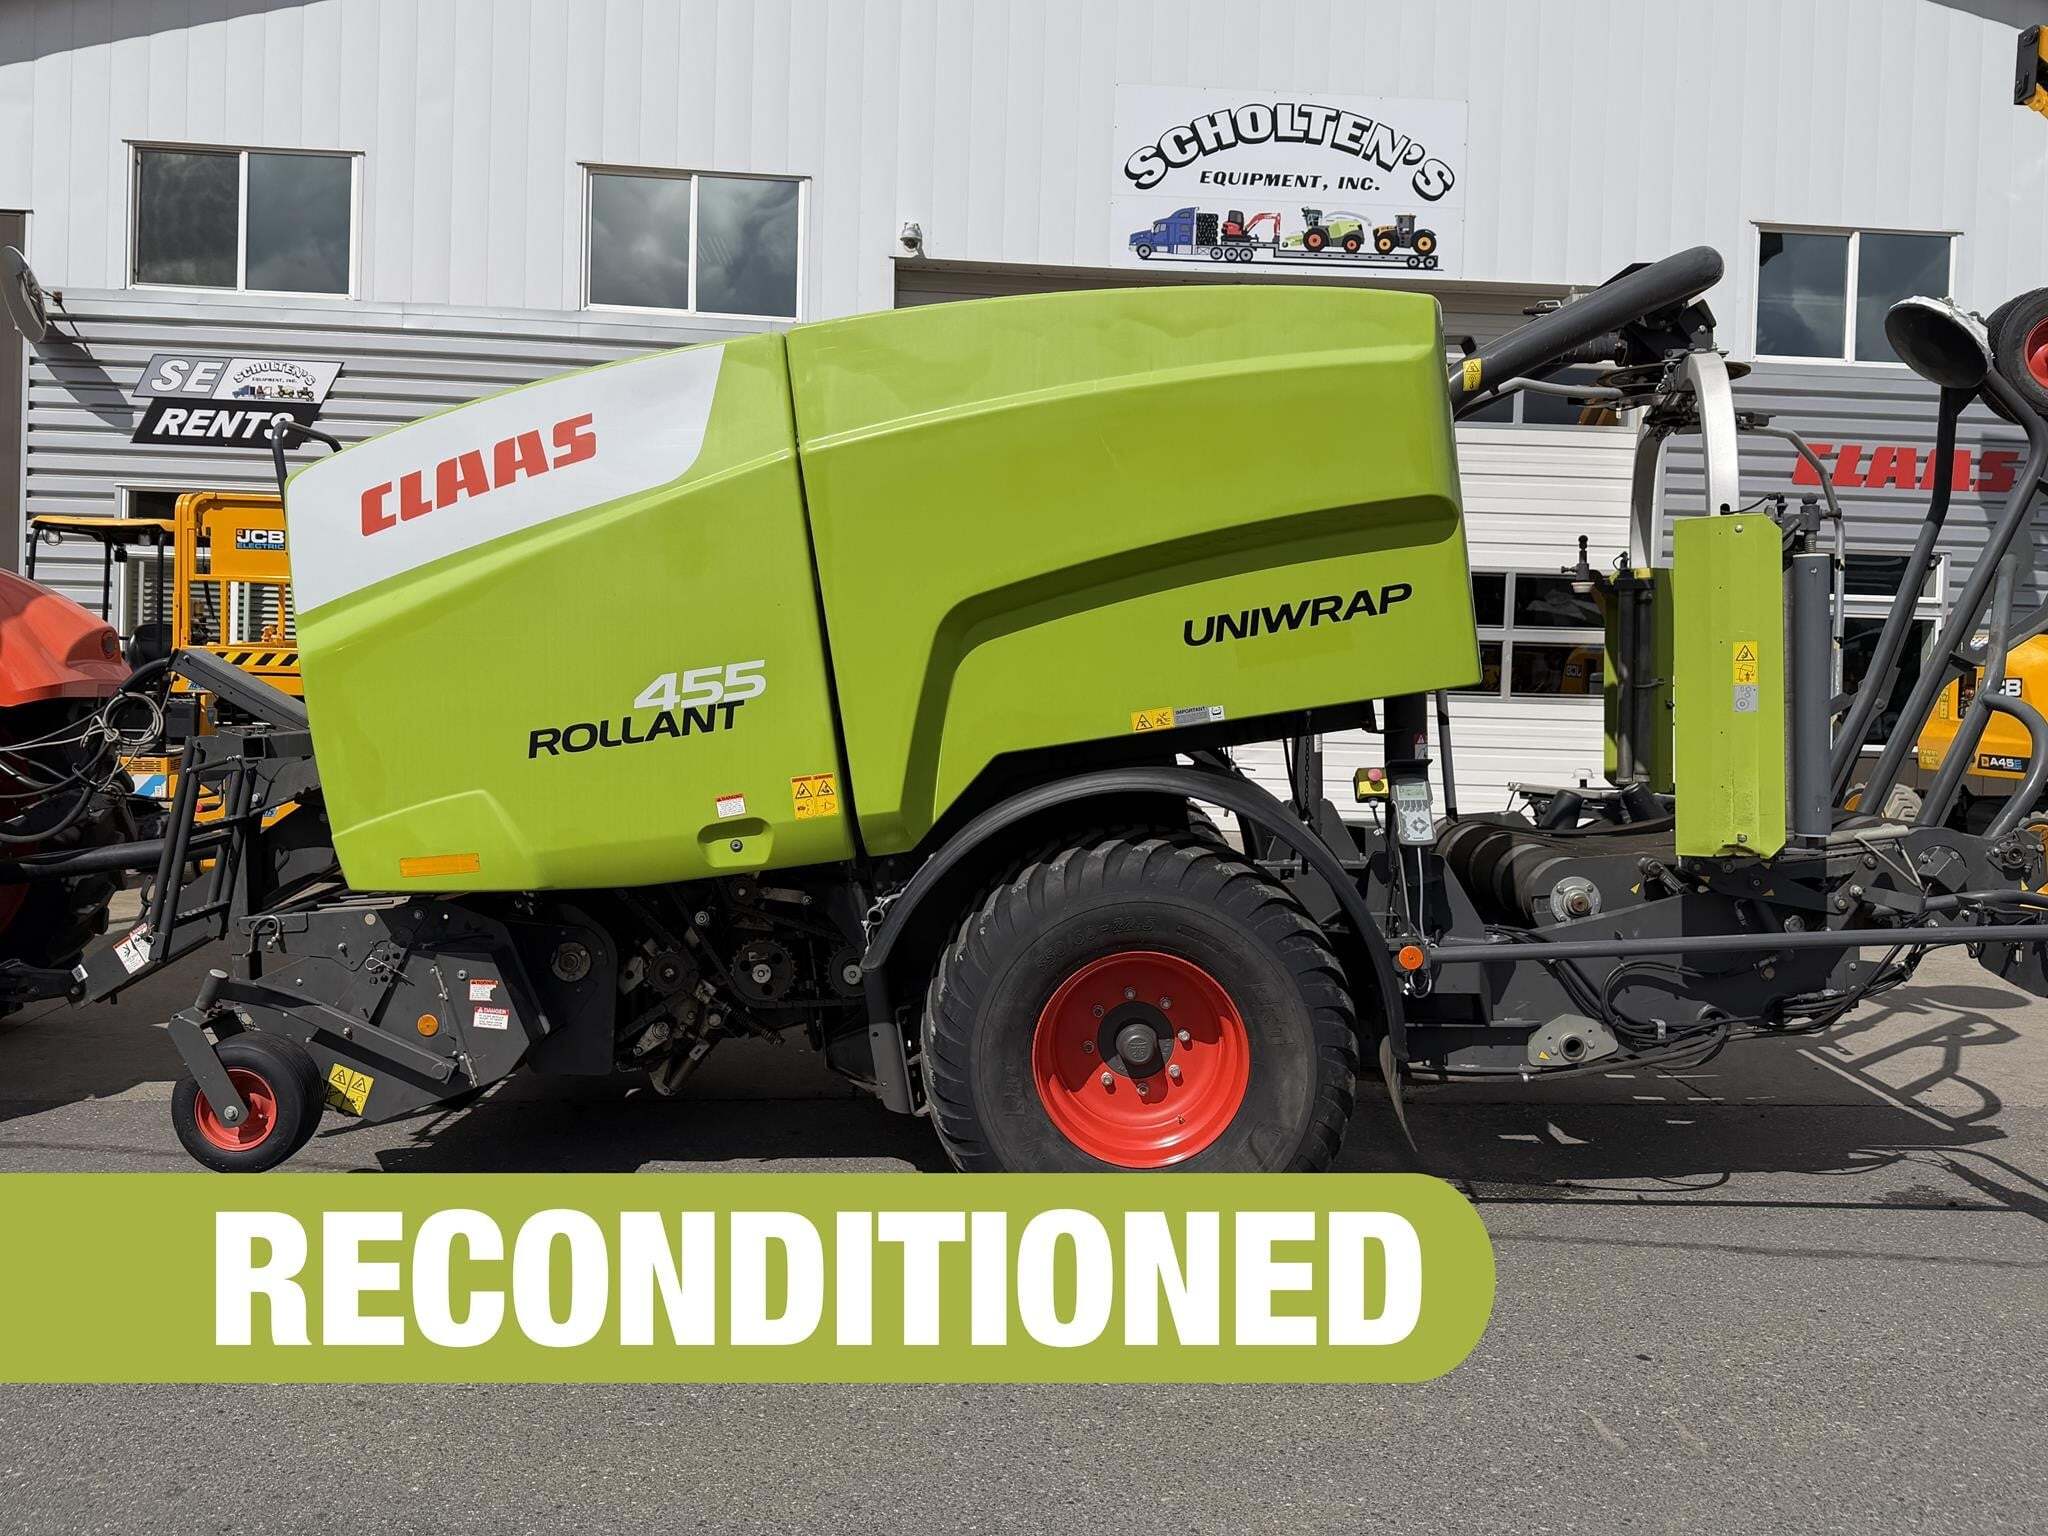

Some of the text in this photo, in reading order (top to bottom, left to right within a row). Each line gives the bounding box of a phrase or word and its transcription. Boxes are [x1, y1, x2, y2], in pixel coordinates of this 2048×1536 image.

[1124, 103, 1455, 202] SCHOLTEN'S
[1200, 170, 1381, 191] EQUIPMENT, INC.
[151, 358, 224, 393] SE
[233, 361, 316, 386] SCHOLTEN'S
[152, 407, 295, 440] RENTS
[361, 412, 597, 537] CLAAS
[1792, 443, 2021, 492] CLAAS
[236, 542, 285, 550] ELECTRIC
[237, 530, 285, 543] JCB
[1183, 582, 1413, 647] UNIWRAP
[633, 659, 767, 712] 455
[528, 700, 745, 759] ROLLANT
